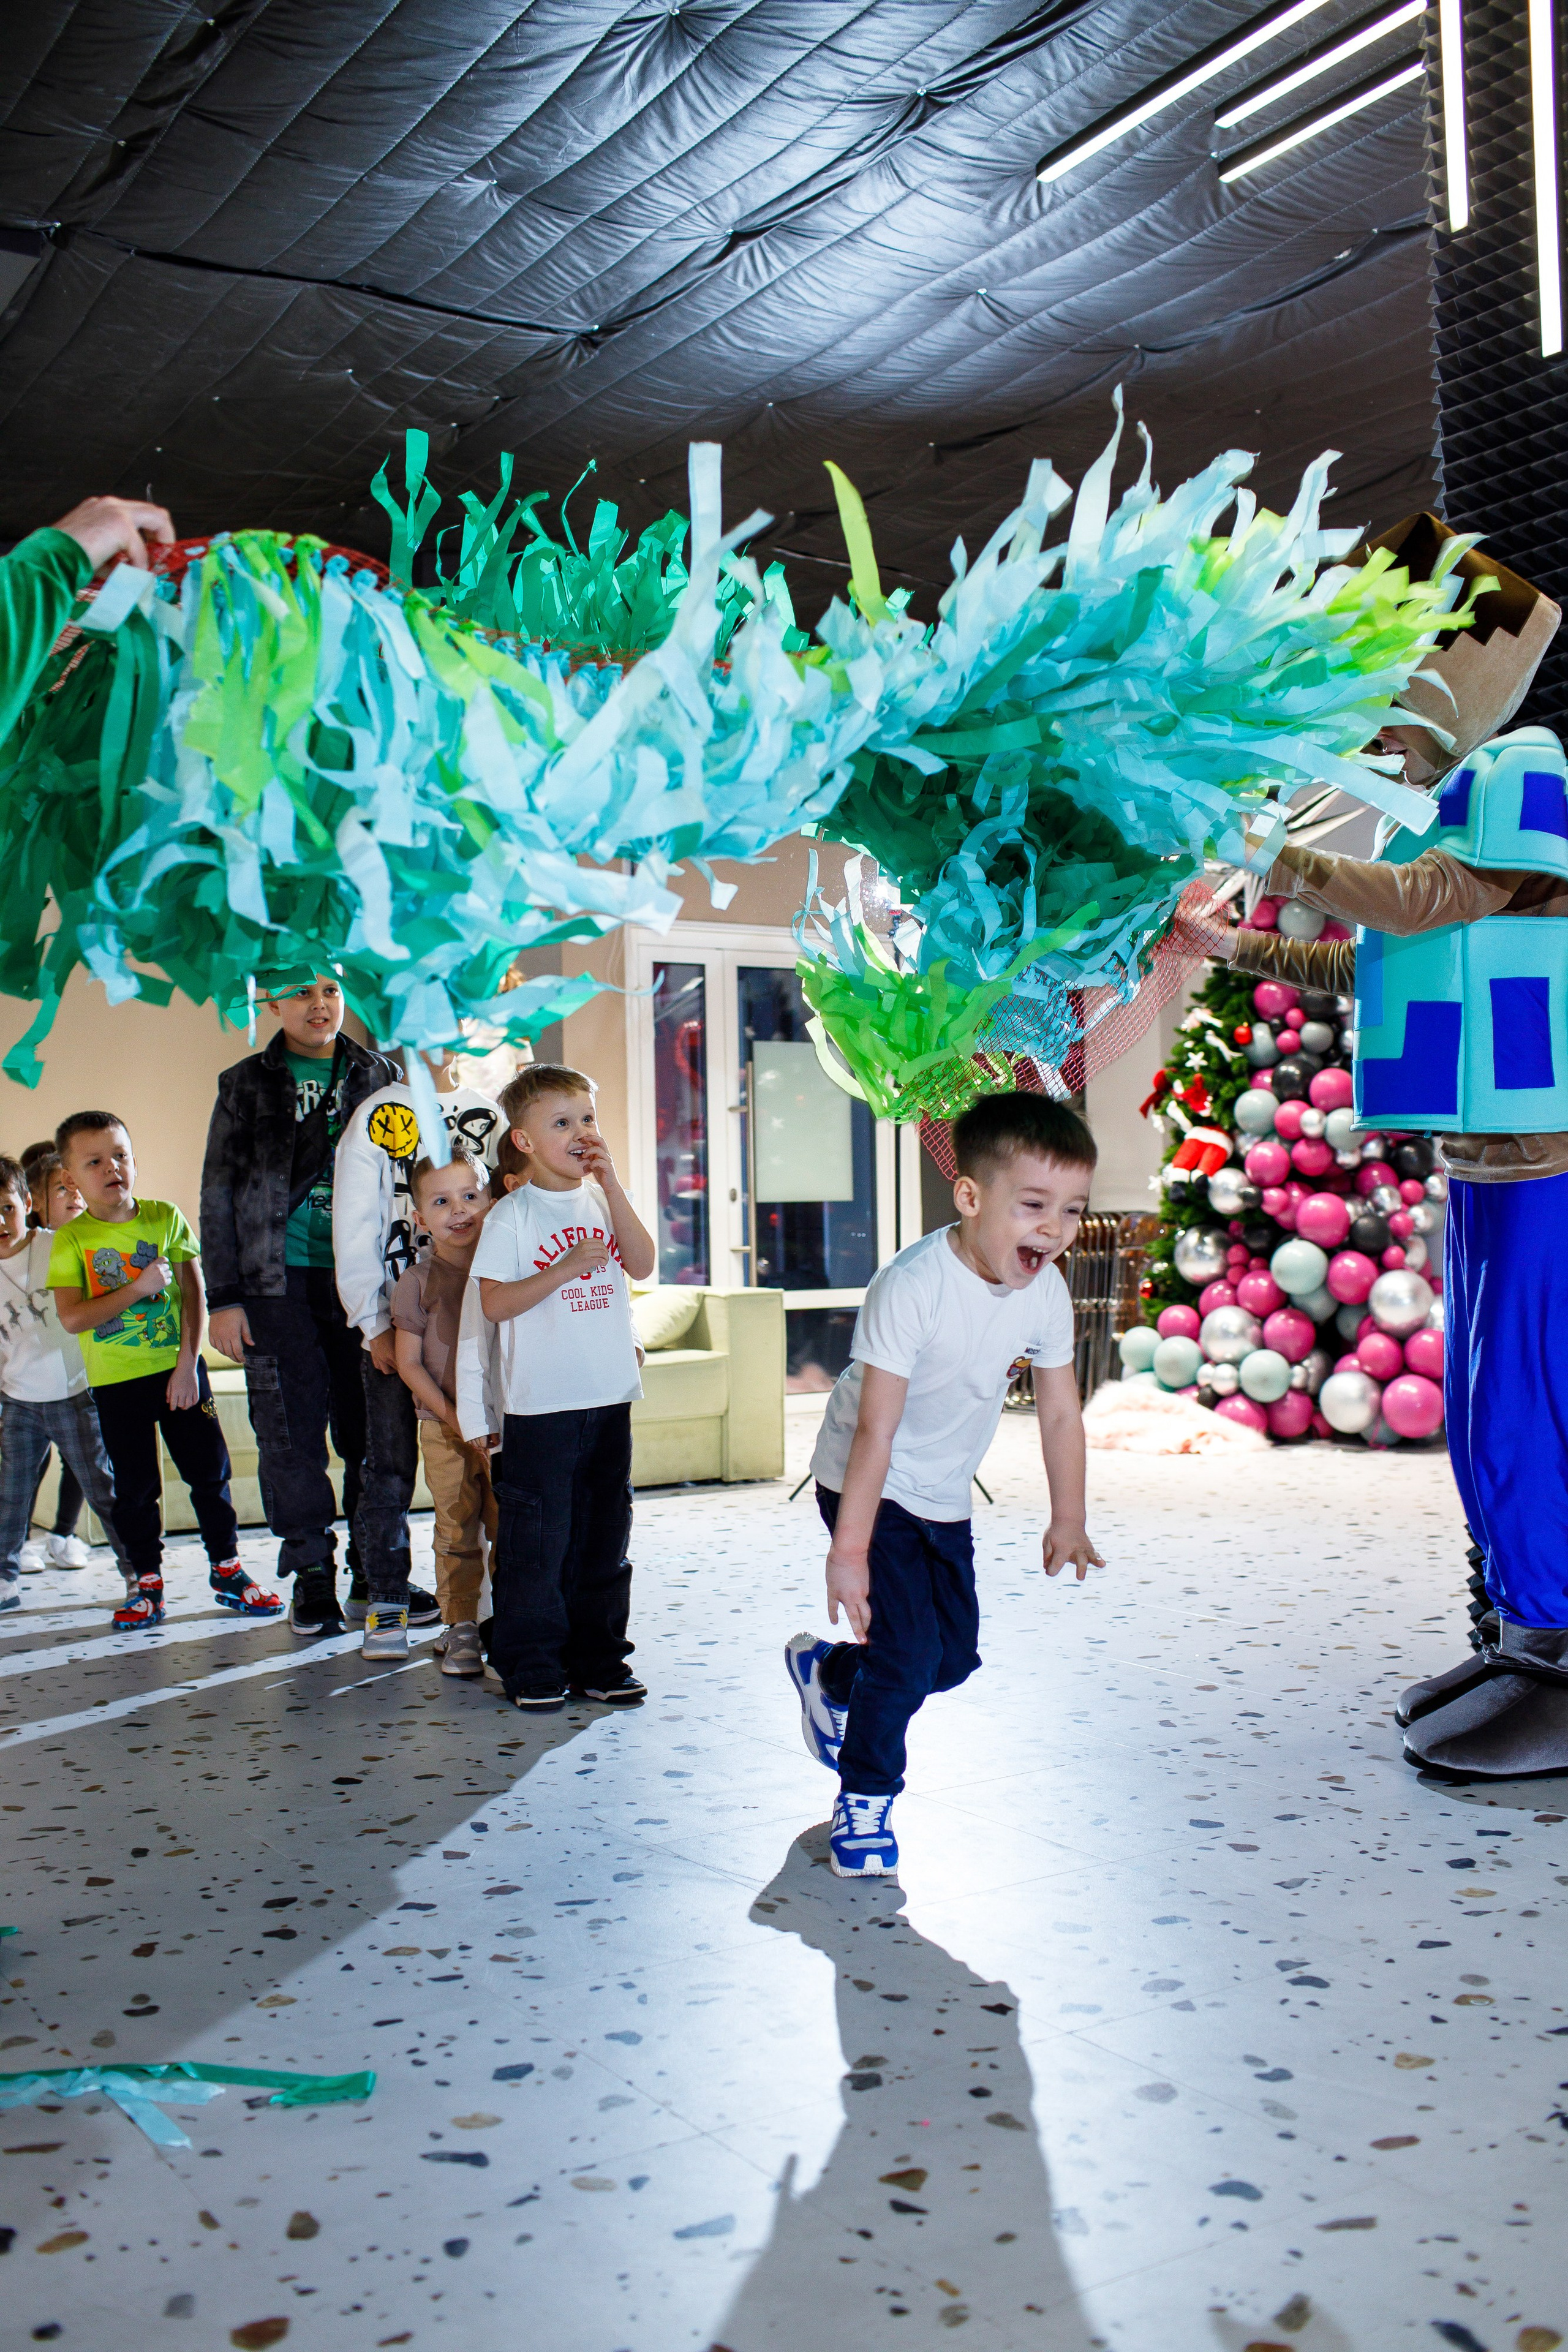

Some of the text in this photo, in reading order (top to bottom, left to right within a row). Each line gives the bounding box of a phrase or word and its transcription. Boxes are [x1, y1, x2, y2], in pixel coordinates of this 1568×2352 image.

[533, 1226, 624, 1277] ALIFORN
[561, 1284, 614, 1300] COOL KIDS
[570, 1298, 610, 1313] LEAGUE
